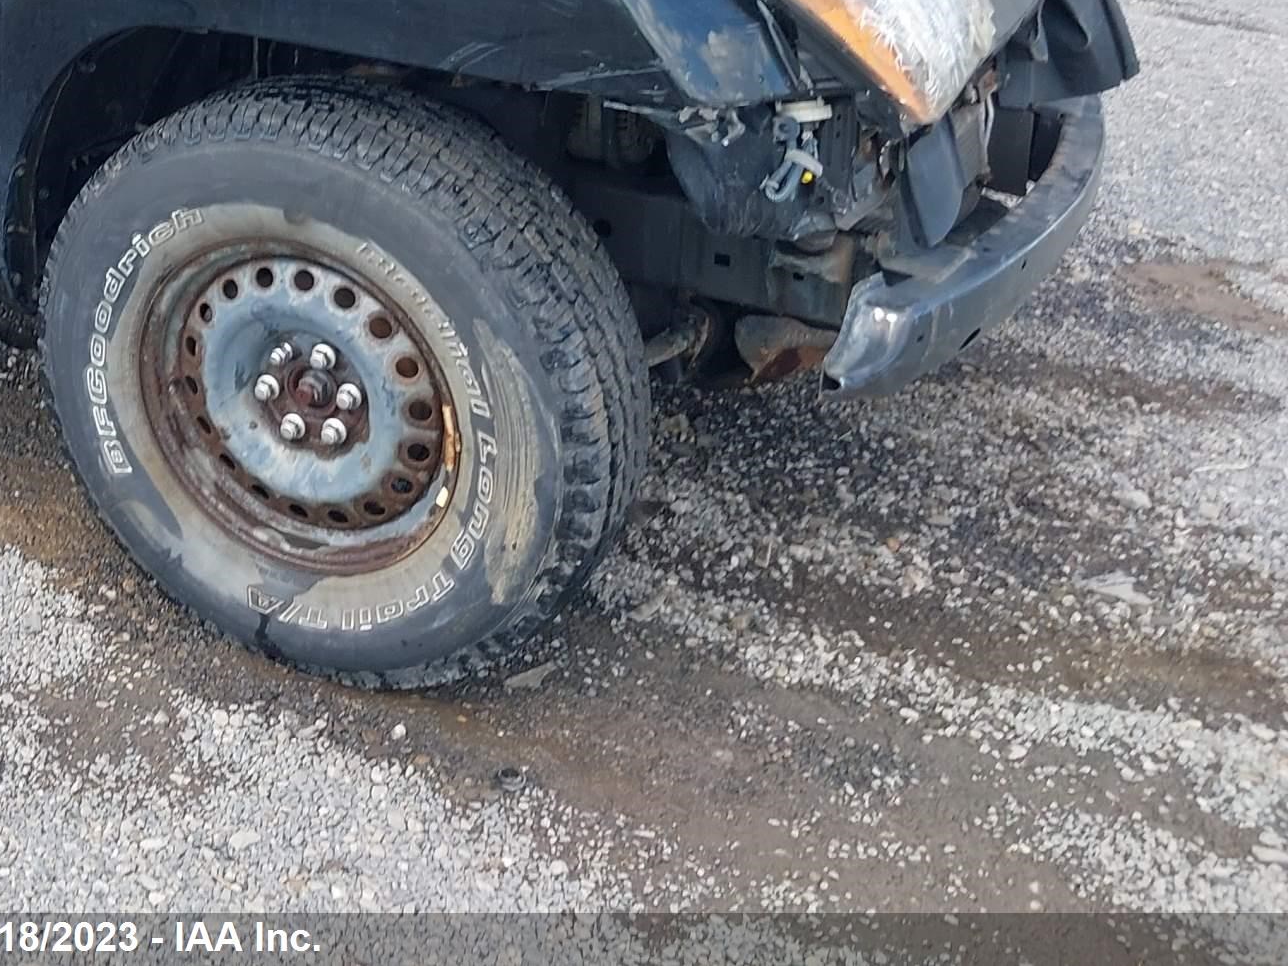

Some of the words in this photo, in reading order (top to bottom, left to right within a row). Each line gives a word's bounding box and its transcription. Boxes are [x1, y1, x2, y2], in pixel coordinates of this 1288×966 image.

[86, 206, 205, 474] BFGoodrich
[450, 430, 498, 571] Long
[247, 584, 328, 630] T/A
[341, 569, 455, 631] Trail
